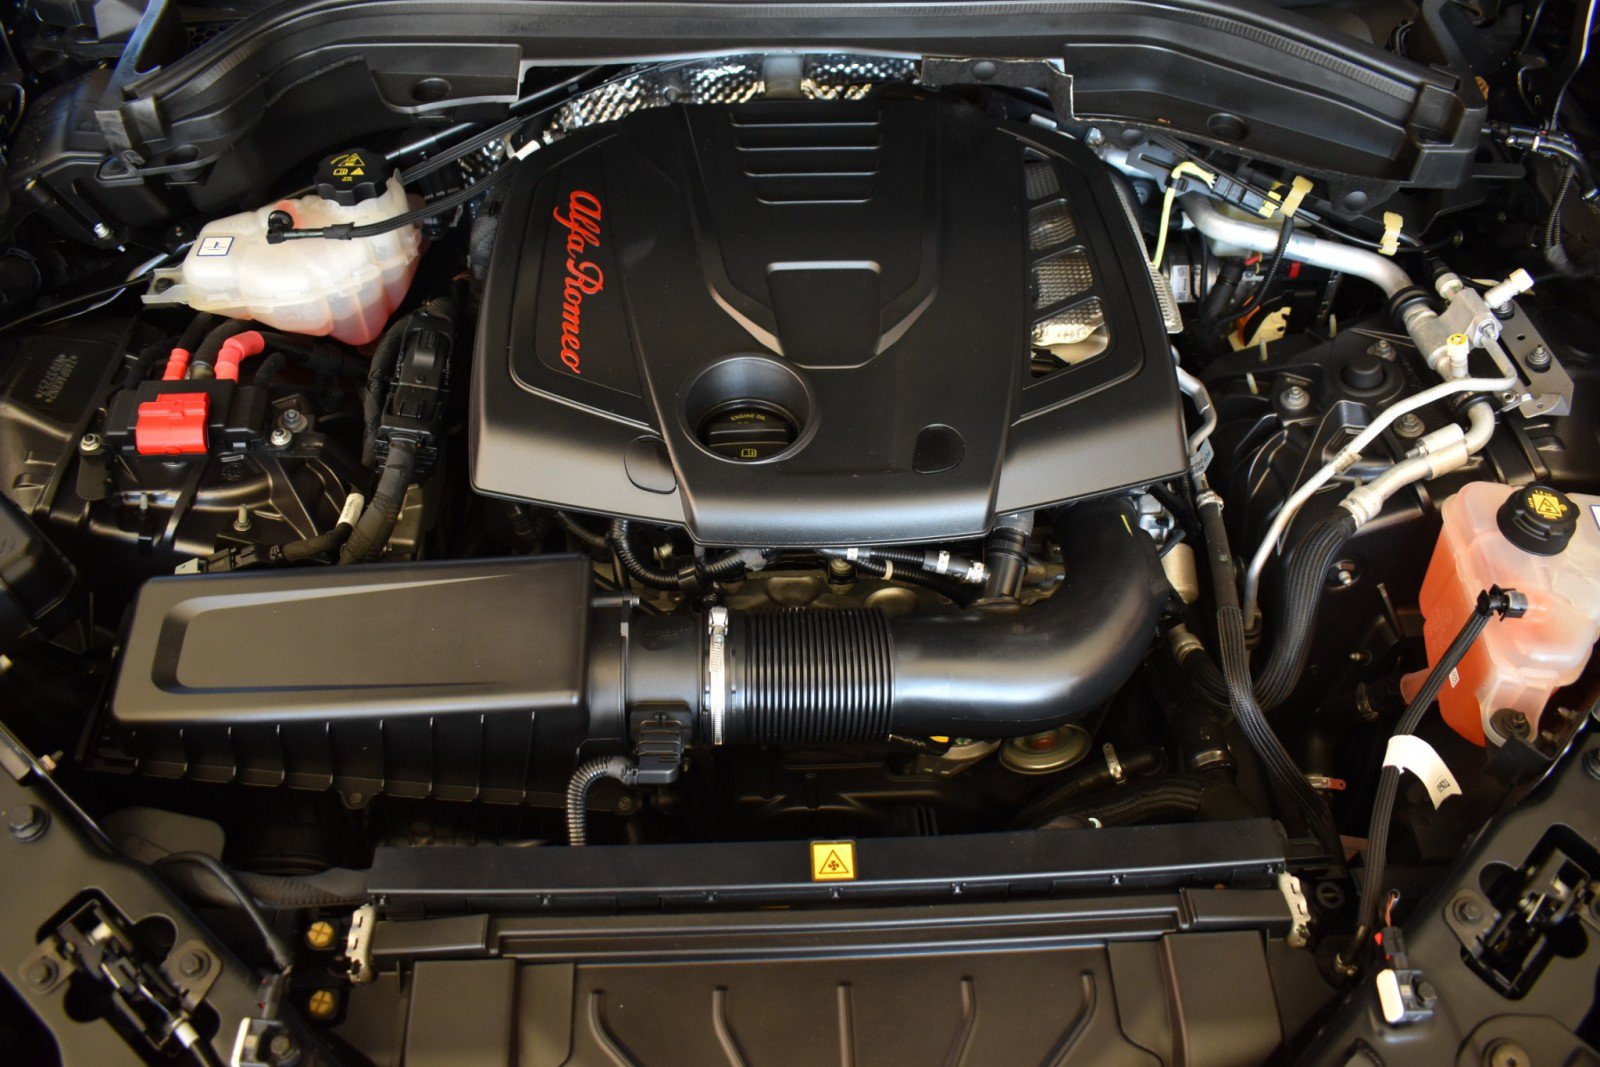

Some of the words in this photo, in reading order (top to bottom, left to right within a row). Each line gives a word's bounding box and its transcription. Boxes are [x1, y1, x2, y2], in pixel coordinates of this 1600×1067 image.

[553, 190, 602, 259] Alfa
[560, 258, 604, 374] Romeo
[730, 413, 755, 421] ENGINE
